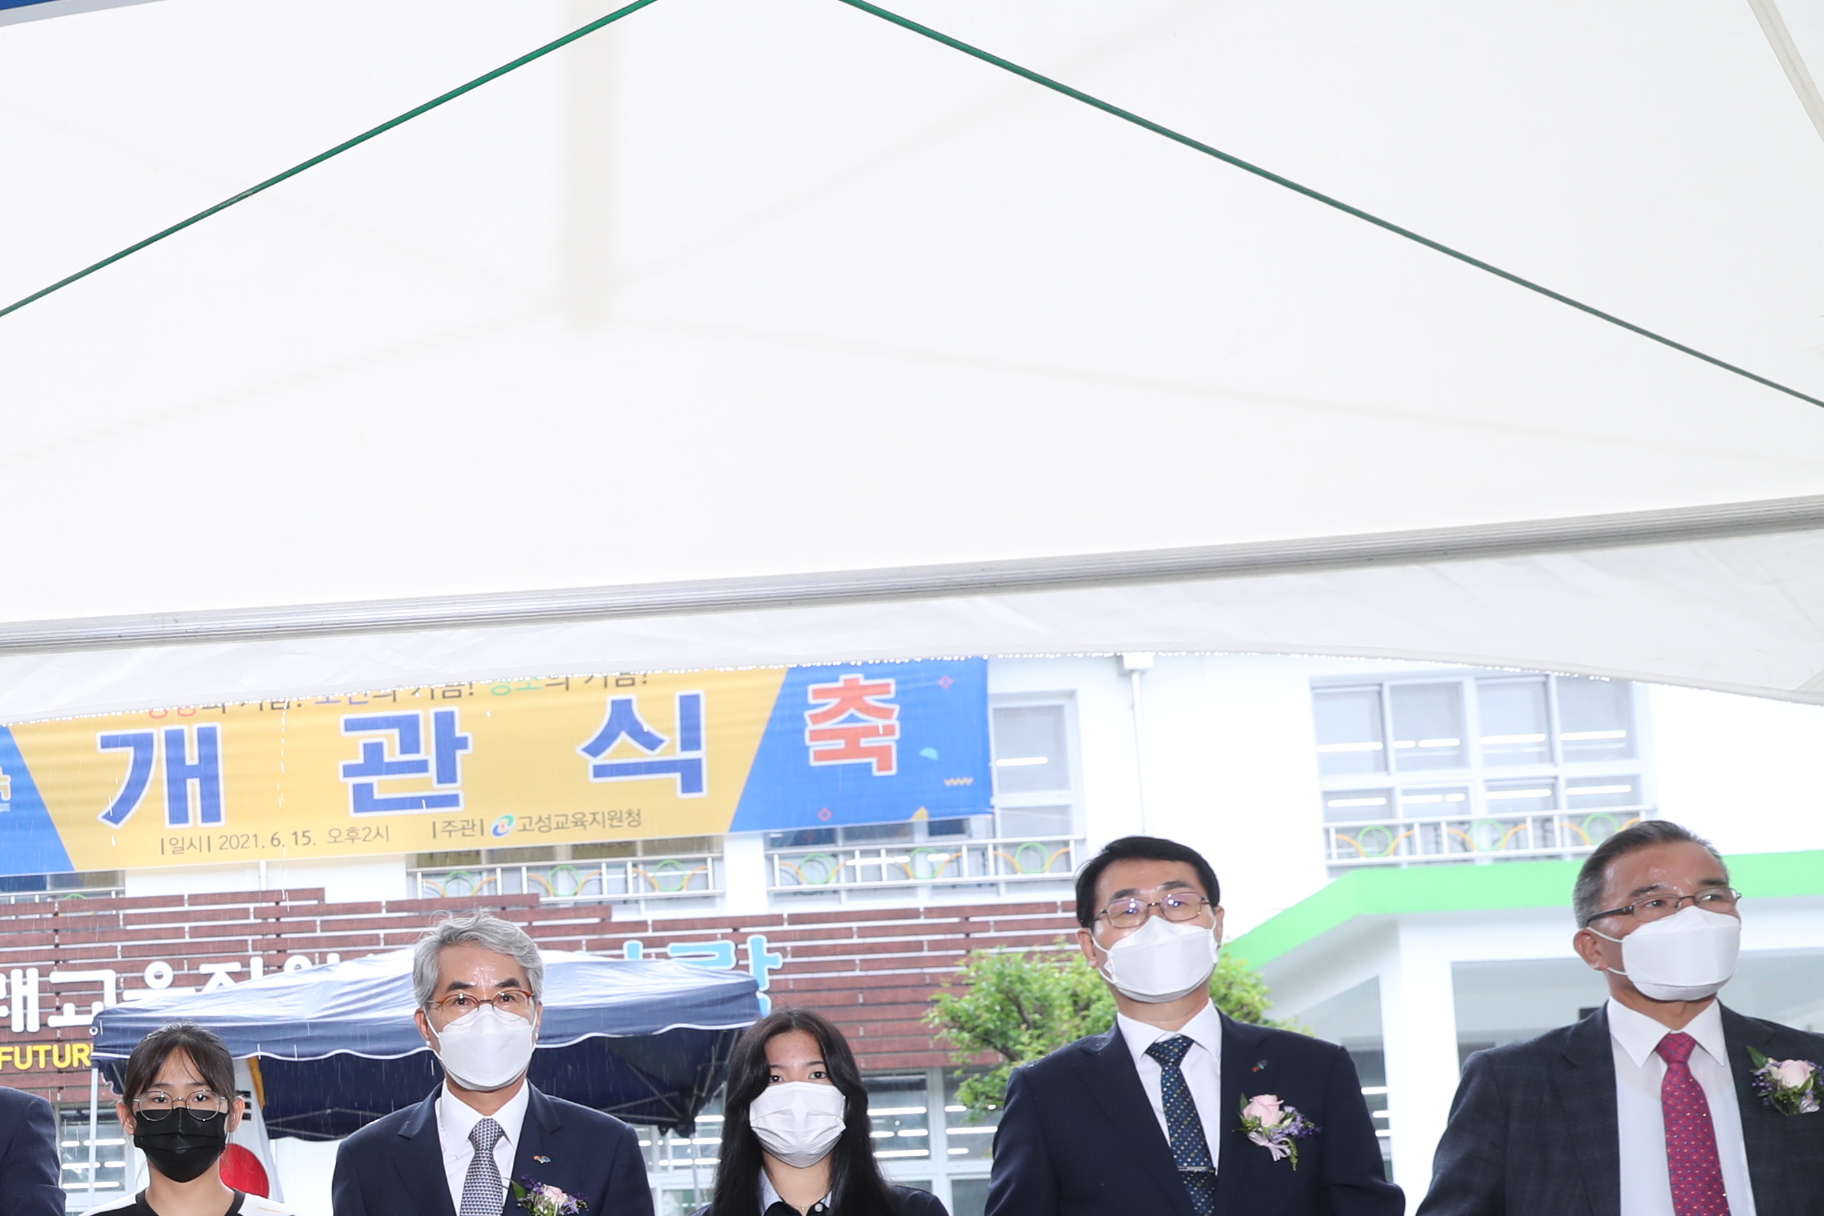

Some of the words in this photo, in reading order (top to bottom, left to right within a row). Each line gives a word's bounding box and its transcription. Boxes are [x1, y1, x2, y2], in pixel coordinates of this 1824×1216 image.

[96, 722, 226, 830] 개
[339, 706, 474, 818] 관
[576, 690, 708, 798] 식
[803, 673, 901, 777] 축
[517, 808, 642, 833] 고성교육지원청
